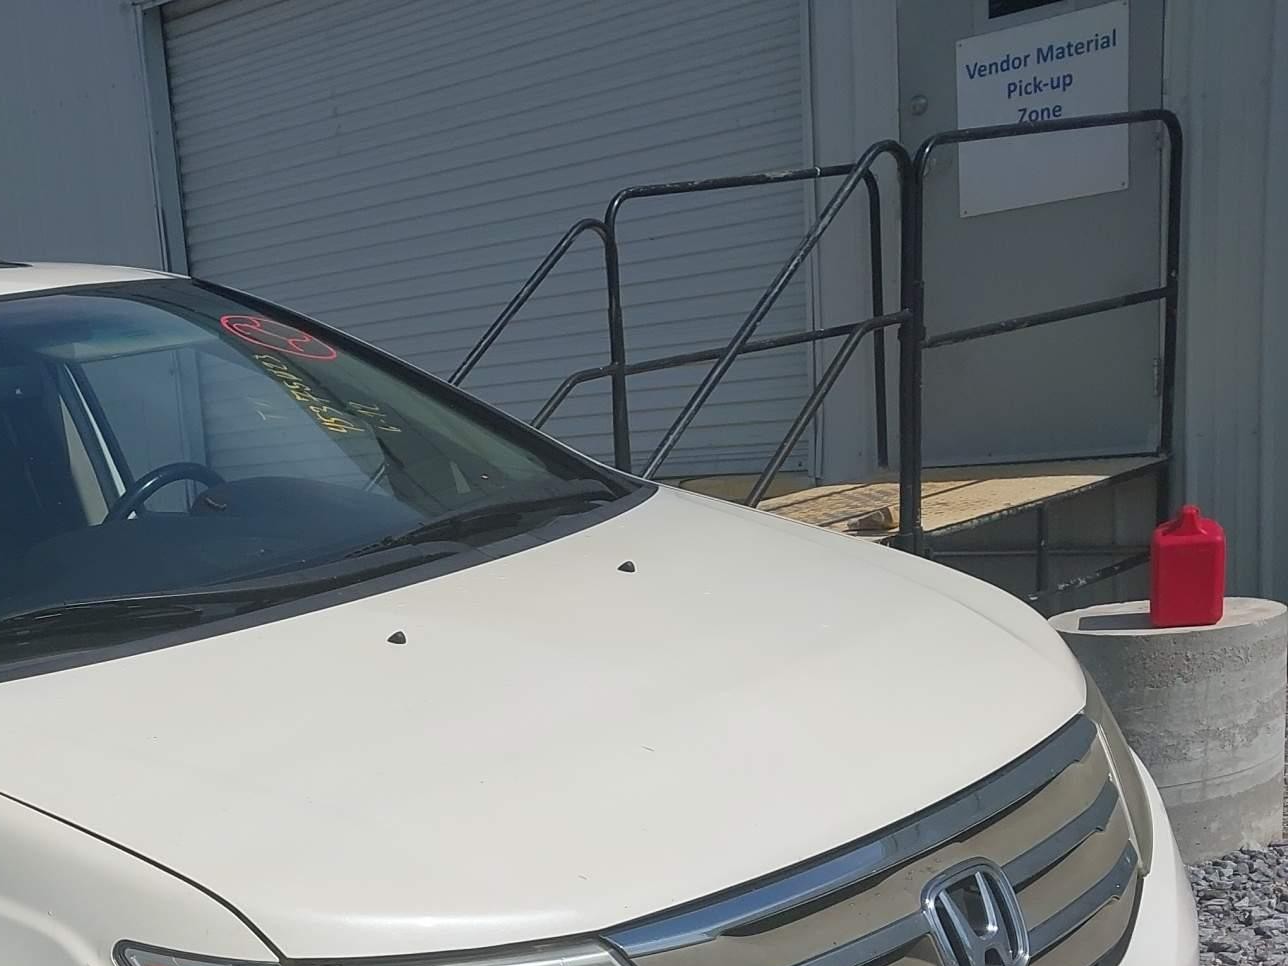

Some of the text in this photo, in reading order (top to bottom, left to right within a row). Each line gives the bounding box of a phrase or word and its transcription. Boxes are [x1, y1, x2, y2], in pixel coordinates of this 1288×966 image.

[965, 28, 1117, 80] Vendor Material
[1007, 73, 1073, 99] Pick-up
